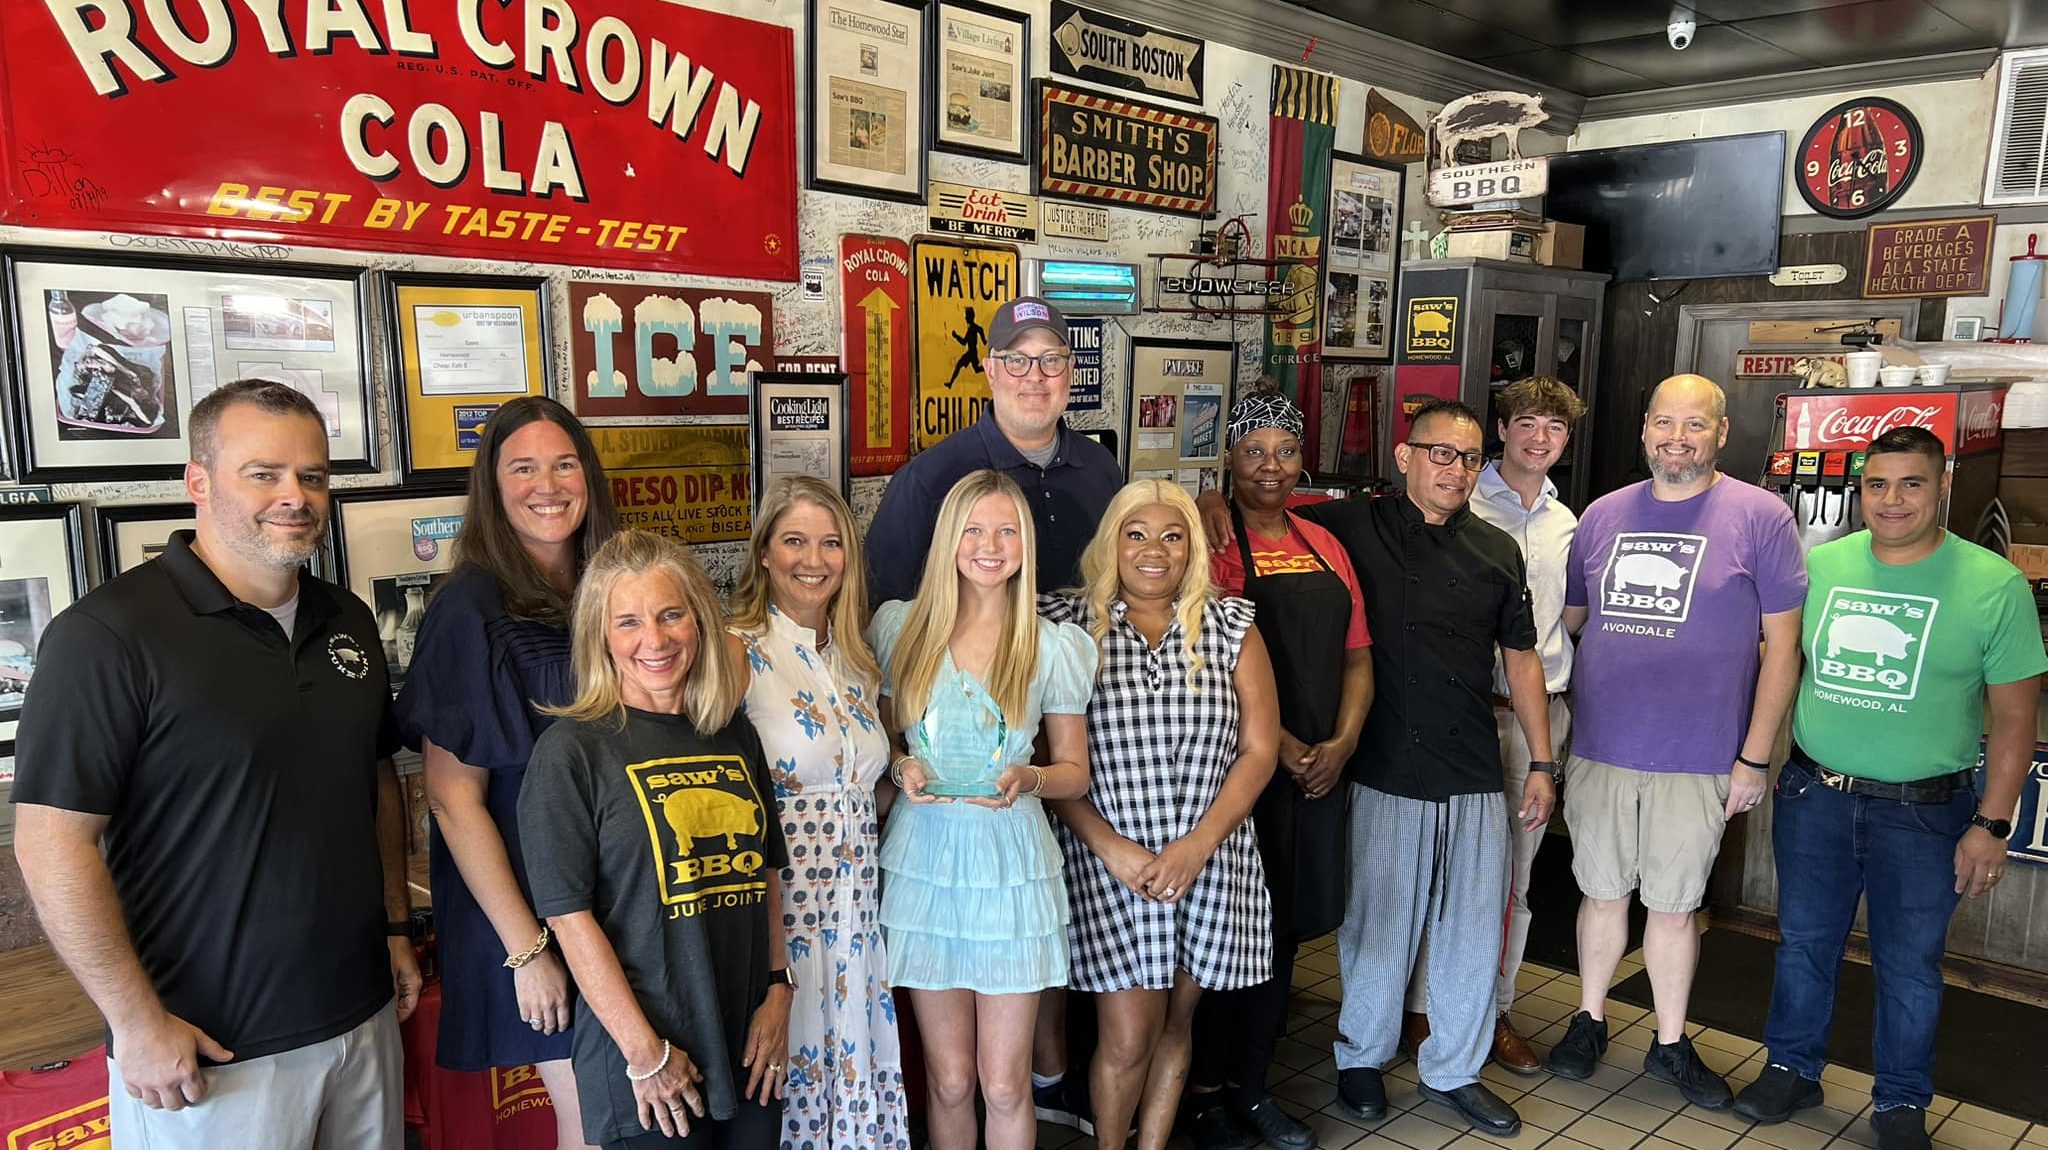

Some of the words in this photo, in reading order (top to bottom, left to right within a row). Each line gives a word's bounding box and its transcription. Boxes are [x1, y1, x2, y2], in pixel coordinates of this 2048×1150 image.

[831, 11, 848, 27] The
[848, 12, 892, 37] Homewood
[891, 25, 906, 41] Star
[1080, 28, 1127, 68] SOUTH
[1132, 45, 1184, 81] BOSTON
[397, 61, 430, 72] REG.
[436, 64, 463, 76] U.S.
[470, 69, 499, 83] PAT.
[507, 77, 536, 92] OFF.
[457, 0, 760, 174] CROWN
[1843, 109, 1866, 128] 12
[1072, 111, 1190, 155] SMITH'S
[340, 93, 588, 199] COLA
[1894, 139, 1907, 156] 3
[1053, 134, 1137, 186] BARBER
[1806, 160, 1820, 177] 9
[1828, 149, 1888, 187] Coca-Cola
[1441, 162, 1536, 180] SOUTHERN
[1453, 175, 1522, 199] BBQ
[207, 182, 351, 223] BEST
[364, 198, 429, 231] BY
[968, 189, 1001, 206] Eat
[1851, 189, 1865, 206] 6
[962, 203, 1007, 223] Drink
[1047, 208, 1075, 224] JUSTICE
[1087, 211, 1106, 228] PEACE
[1895, 227, 1946, 245] GRADE
[1955, 225, 1970, 239] A
[1883, 240, 1974, 261] BEVERAGES
[843, 247, 876, 273] ROYAL
[876, 248, 909, 277] CROWN
[1882, 260, 1913, 276] ALA
[1922, 256, 1969, 273] STATE
[865, 268, 890, 282] COLA
[924, 256, 1009, 301] WATCH
[1871, 275, 1926, 292] HEALTH
[1166, 277, 1295, 295] BUDWEISER
[462, 310, 519, 319] urbanspoon
[1413, 302, 1453, 311] saw's
[583, 291, 763, 397] ICE
[1411, 337, 1451, 349] BBQ
[1077, 355, 1099, 364] WALLS
[771, 398, 807, 418] Cooking
[807, 398, 828, 416] Light
[924, 397, 992, 435] CHILD
[777, 415, 795, 425] BEST
[795, 415, 825, 425] RECIPES
[612, 475, 677, 507] RESO
[652, 510, 672, 522] ALL
[678, 507, 702, 520] LIVE
[706, 504, 742, 519] STOCK
[1620, 540, 1697, 556] saw's
[1606, 590, 1682, 615] BBQ
[1834, 597, 1925, 620] saw's
[1601, 622, 1676, 639] AVONDALE
[1818, 658, 1909, 691] BBQ
[1887, 703, 1908, 714] AL
[645, 765, 745, 790] saw's
[669, 850, 764, 885] BBQ
[712, 890, 766, 909] JOINT
